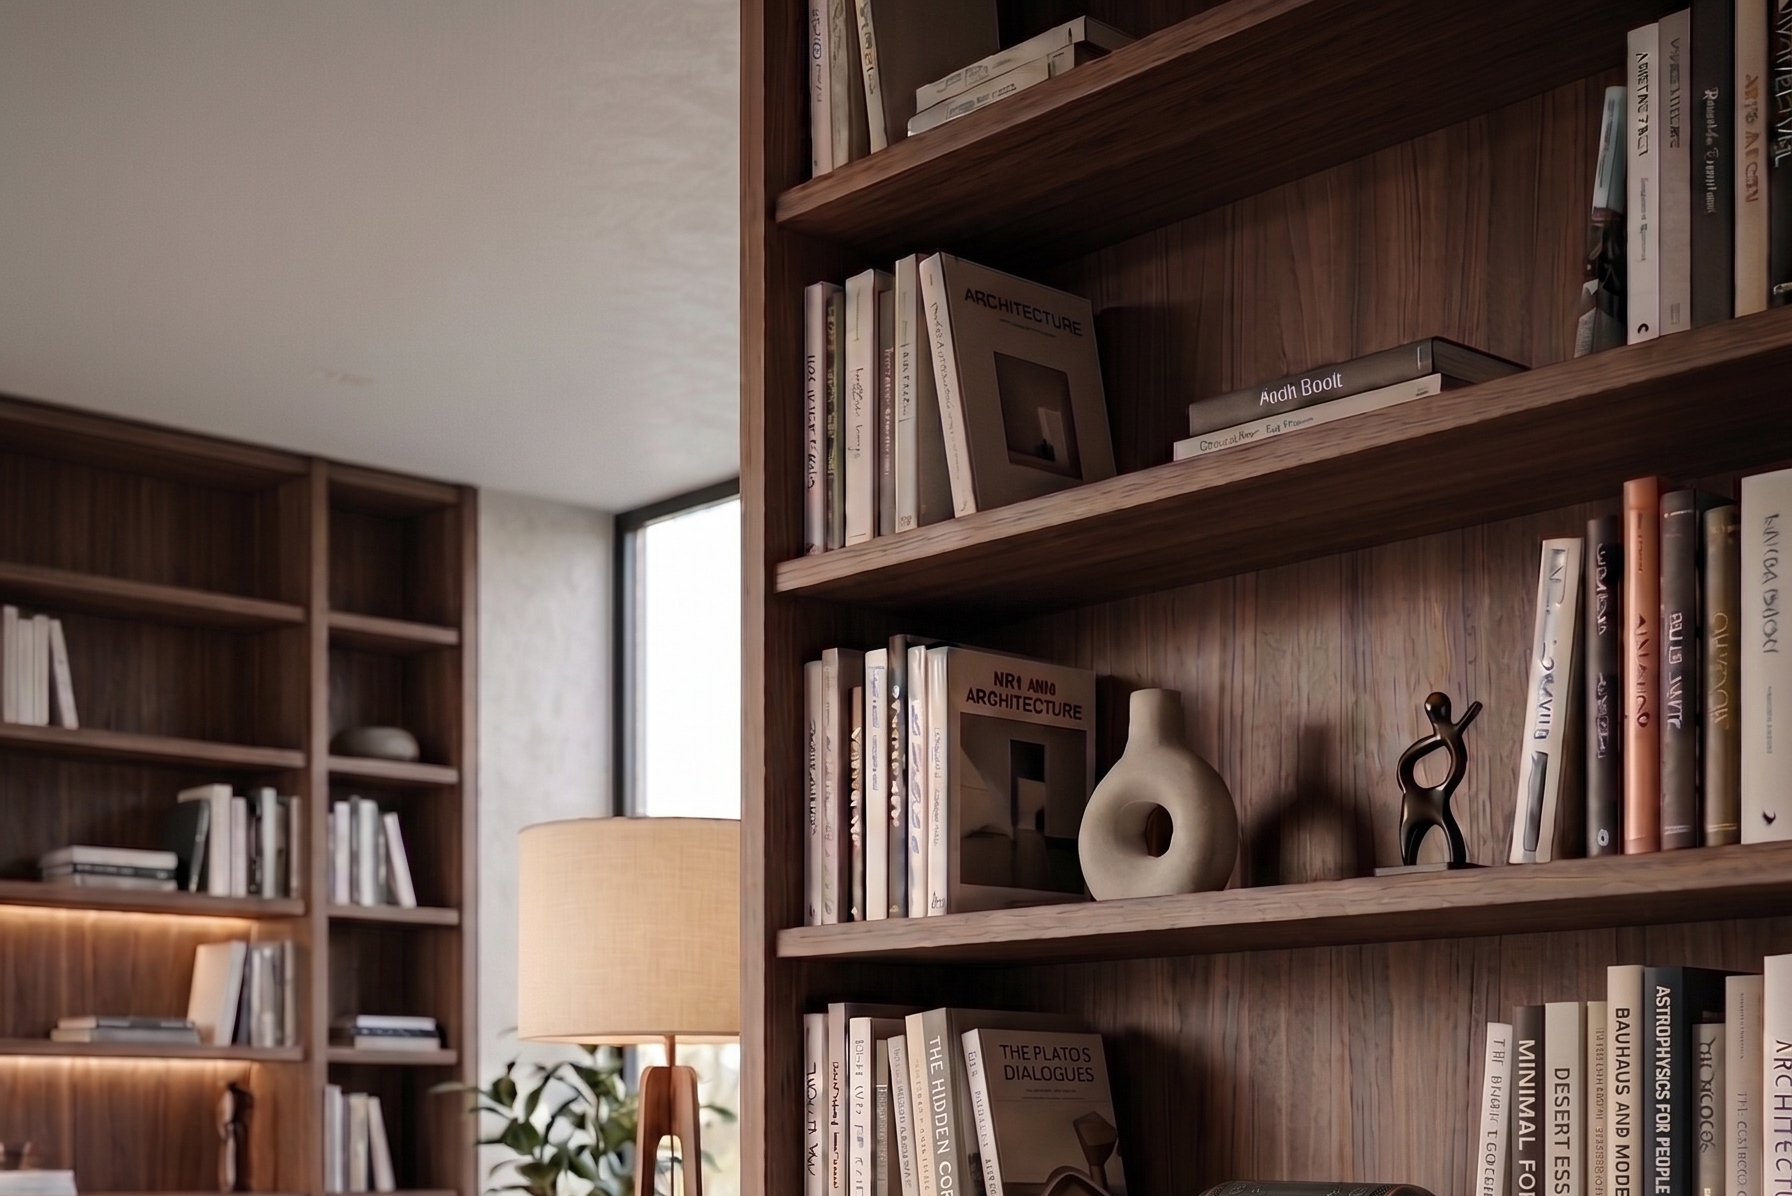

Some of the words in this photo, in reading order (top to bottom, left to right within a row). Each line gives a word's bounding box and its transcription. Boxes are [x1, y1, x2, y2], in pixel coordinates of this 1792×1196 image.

[965, 288, 1083, 336] ARCHITECTURE
[928, 1035, 944, 1075] THE
[999, 1044, 1030, 1060] THE
[1616, 1007, 1631, 1096] BAUHAUS
[1655, 986, 1671, 1099] ASTROPHYSICS
[1004, 1064, 1094, 1082] DIALOGUES
[1518, 1039, 1536, 1151] MINIMAL
[932, 1078, 951, 1156] HIDDEN
[1554, 1068, 1571, 1150] DESERT
[1616, 1101, 1631, 1138] AND
[1655, 1104, 1671, 1133] FOR
[1655, 1137, 1671, 1194] PEOPLE
